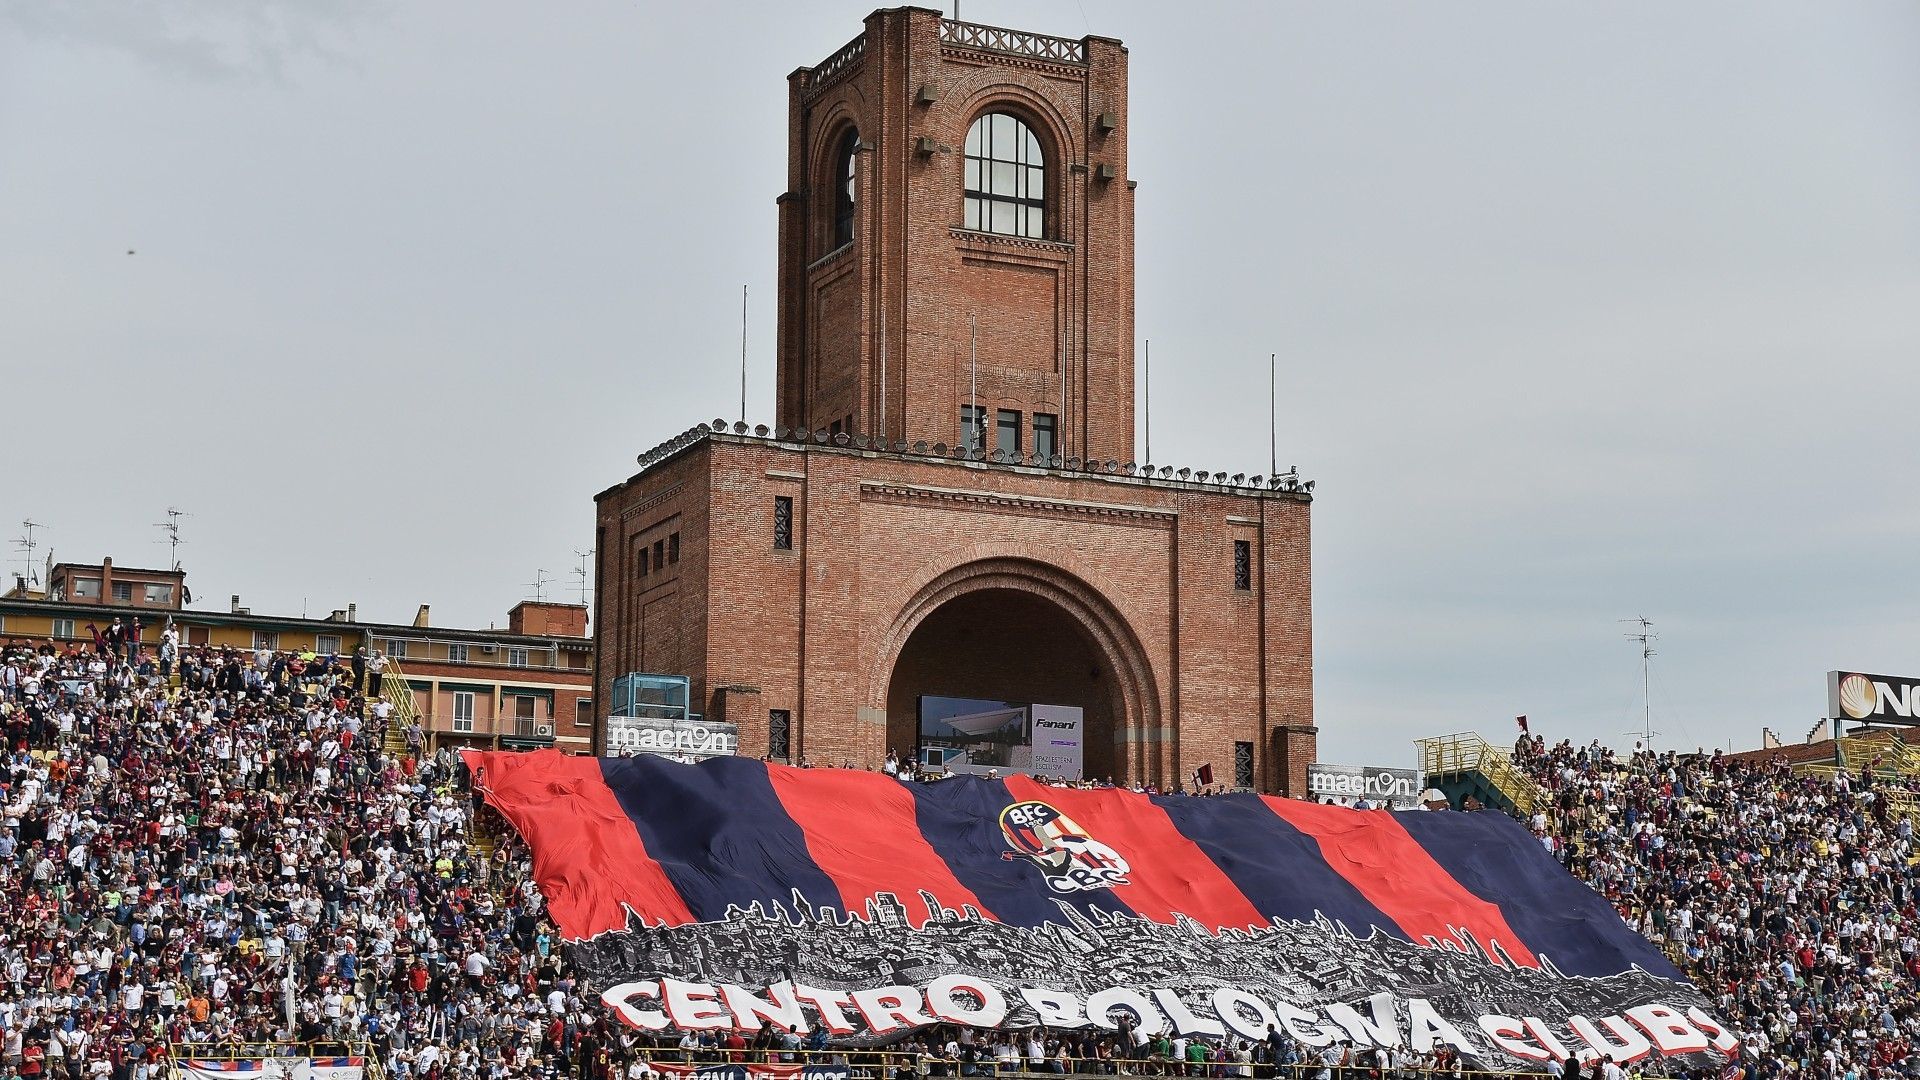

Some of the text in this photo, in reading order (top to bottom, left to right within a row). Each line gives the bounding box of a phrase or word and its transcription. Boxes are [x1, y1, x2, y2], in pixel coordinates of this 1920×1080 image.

[1036, 719, 1077, 730] Fanani
[612, 726, 728, 751] macron
[1313, 772, 1410, 796] macron
[1009, 804, 1049, 825] BFC
[1046, 868, 1130, 892] CBC
[600, 974, 1740, 1067] CENTRO BOLOGNA CLUBS
[600, 1053, 606, 1065] 8
